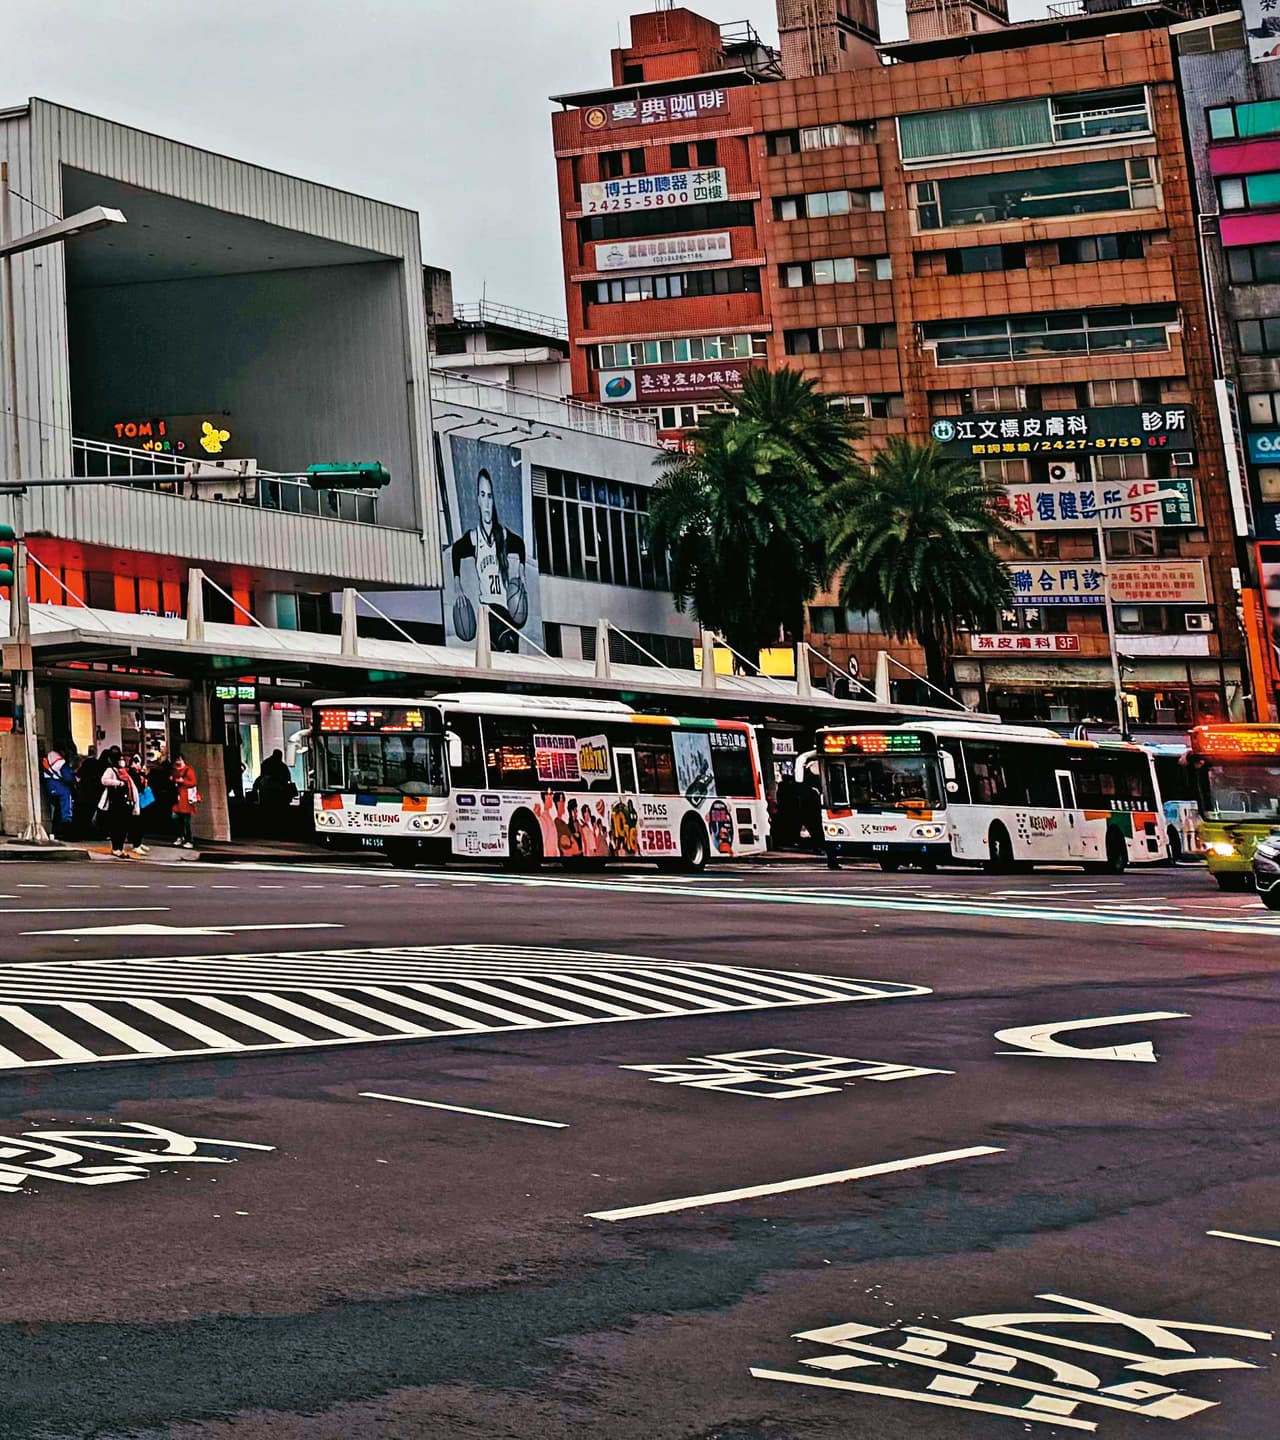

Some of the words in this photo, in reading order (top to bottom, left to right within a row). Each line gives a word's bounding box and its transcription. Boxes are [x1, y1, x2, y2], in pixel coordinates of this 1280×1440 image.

[604, 174, 688, 198] 博士助聽器
[589, 191, 688, 212] 2425-5800
[956, 415, 1088, 441] 江文標皮膚科
[1141, 410, 1185, 432] 診所
[1130, 504, 1158, 523] 5F
[489, 575, 501, 594] 20
[1059, 638, 1074, 650] 3F
[363, 812, 400, 824] KEELUNG
[642, 803, 667, 816] TPASS
[1029, 815, 1058, 831] KEELUNG
